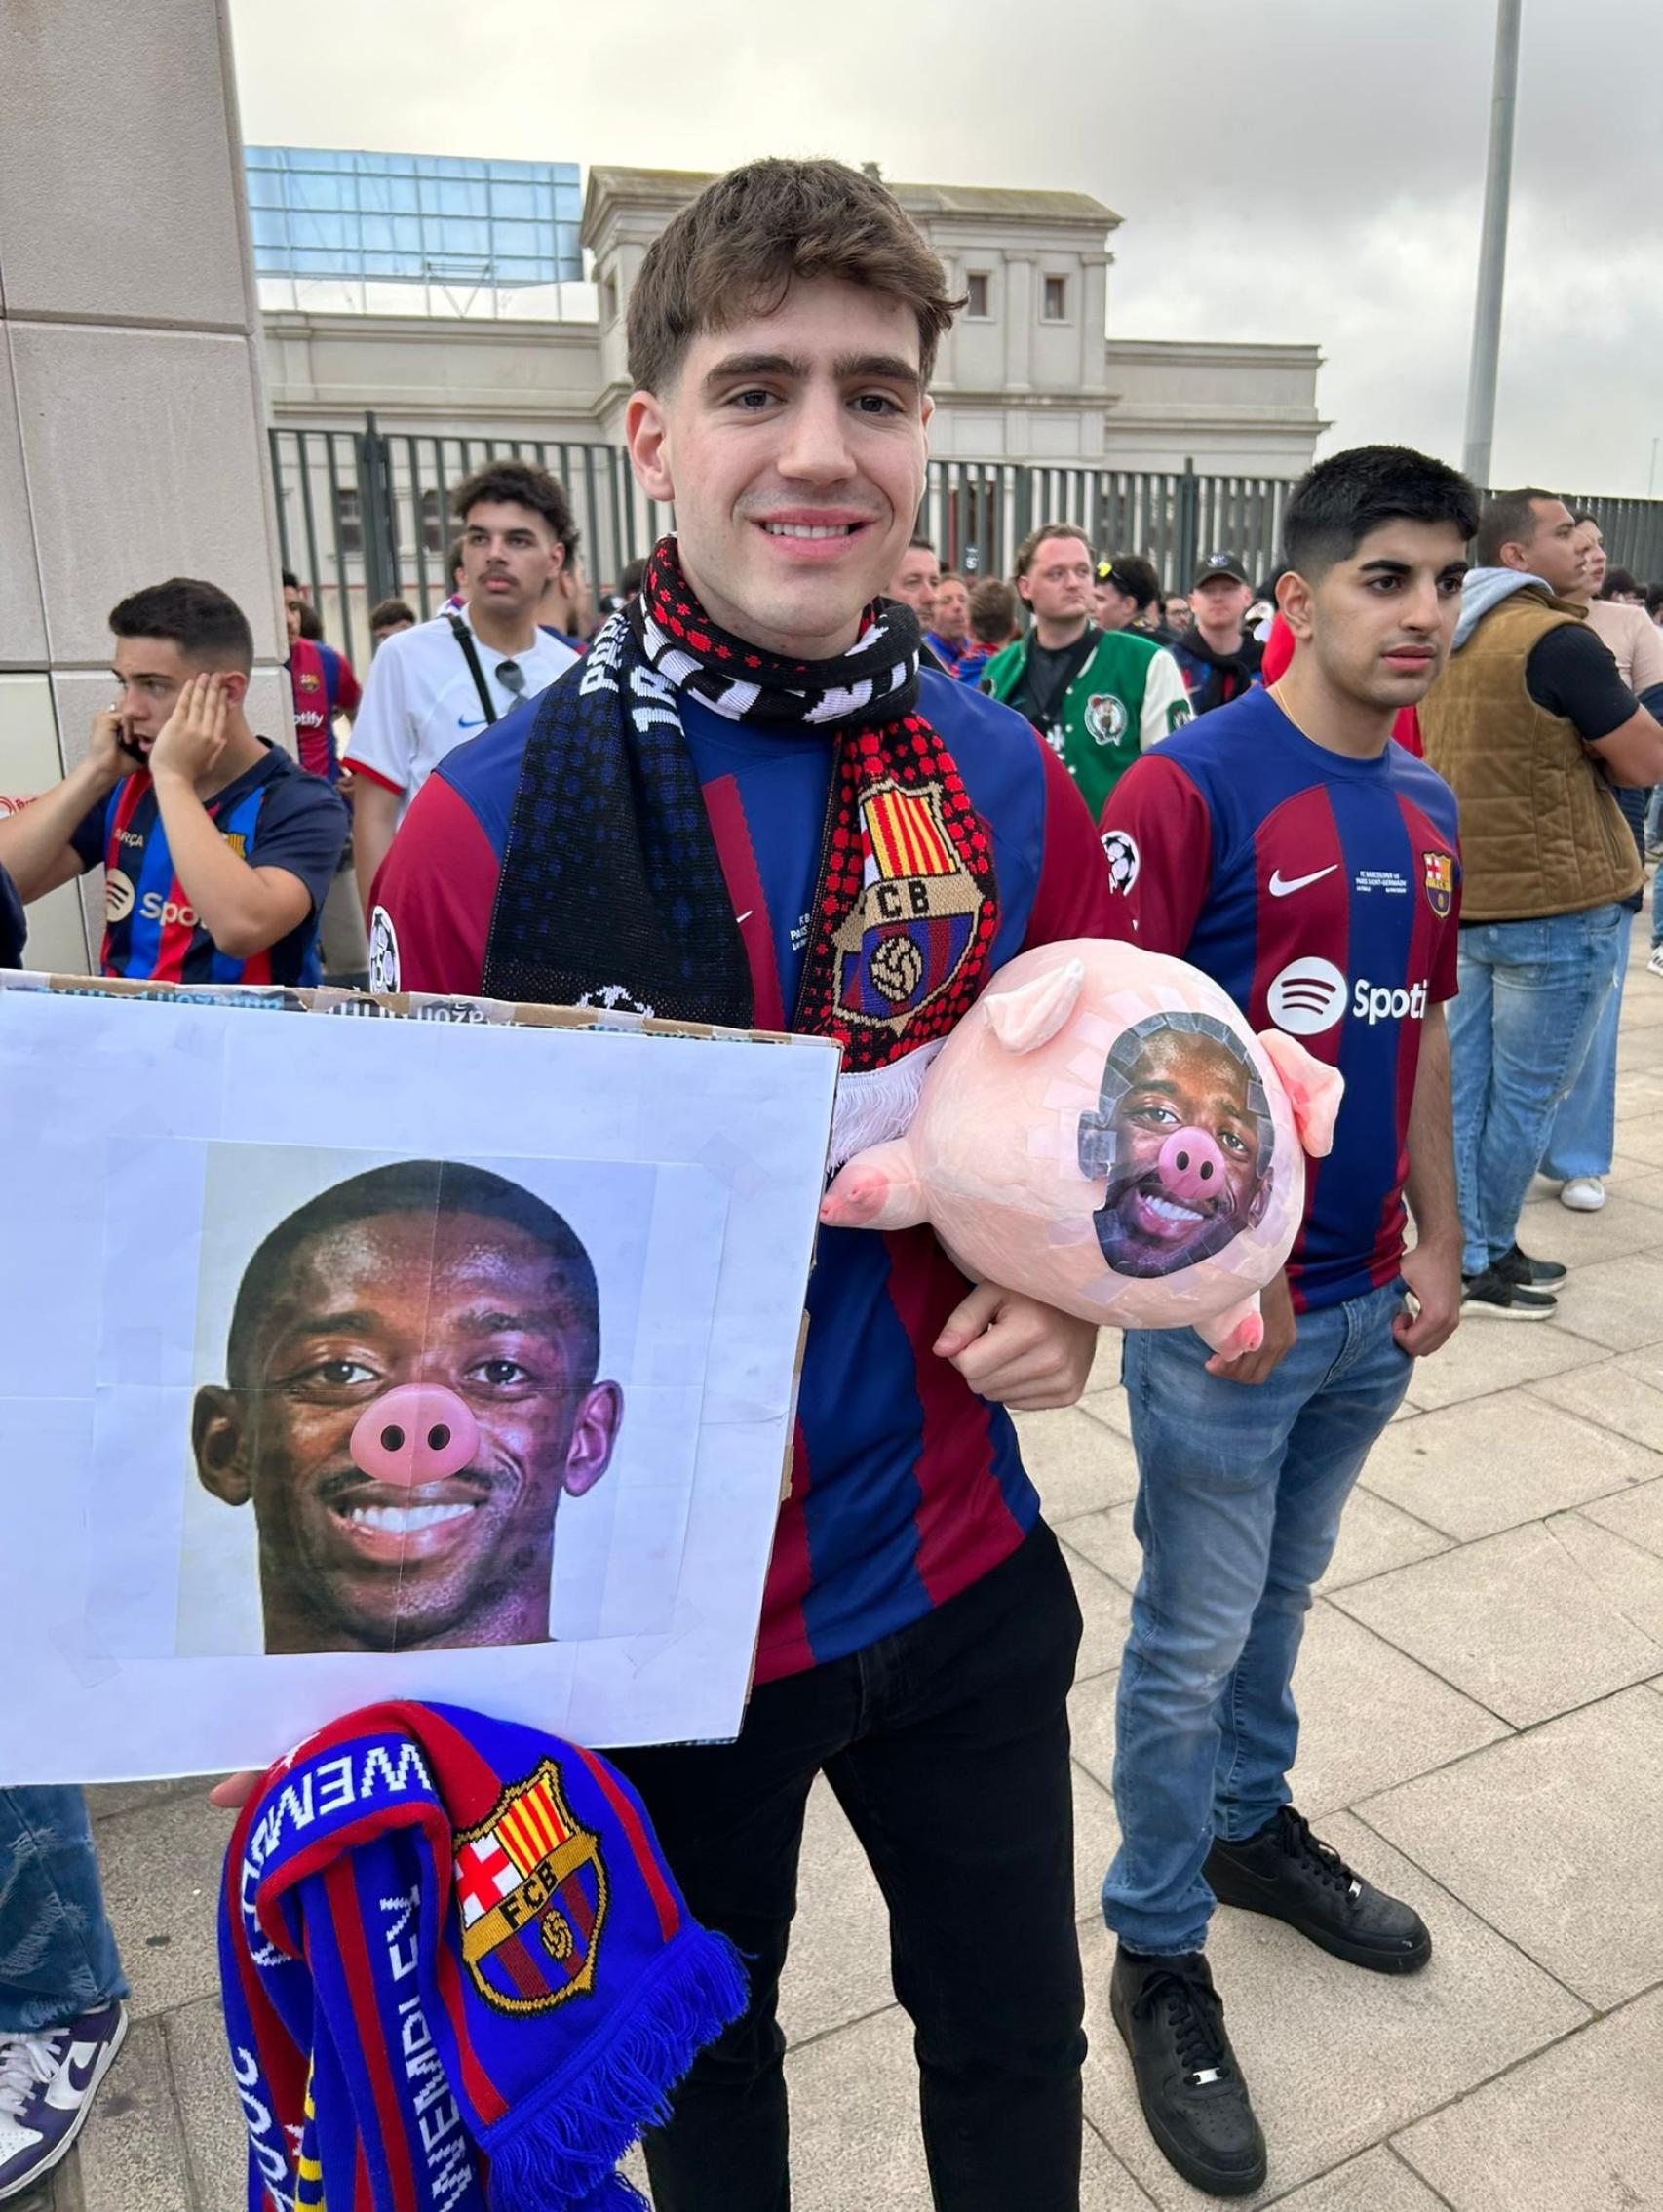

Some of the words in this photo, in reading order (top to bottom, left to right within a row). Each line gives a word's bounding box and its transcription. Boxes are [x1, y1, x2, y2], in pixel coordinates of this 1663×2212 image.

[139, 892, 203, 927] Spo
[875, 880, 930, 917] CB
[497, 1860, 559, 1930] FCB
